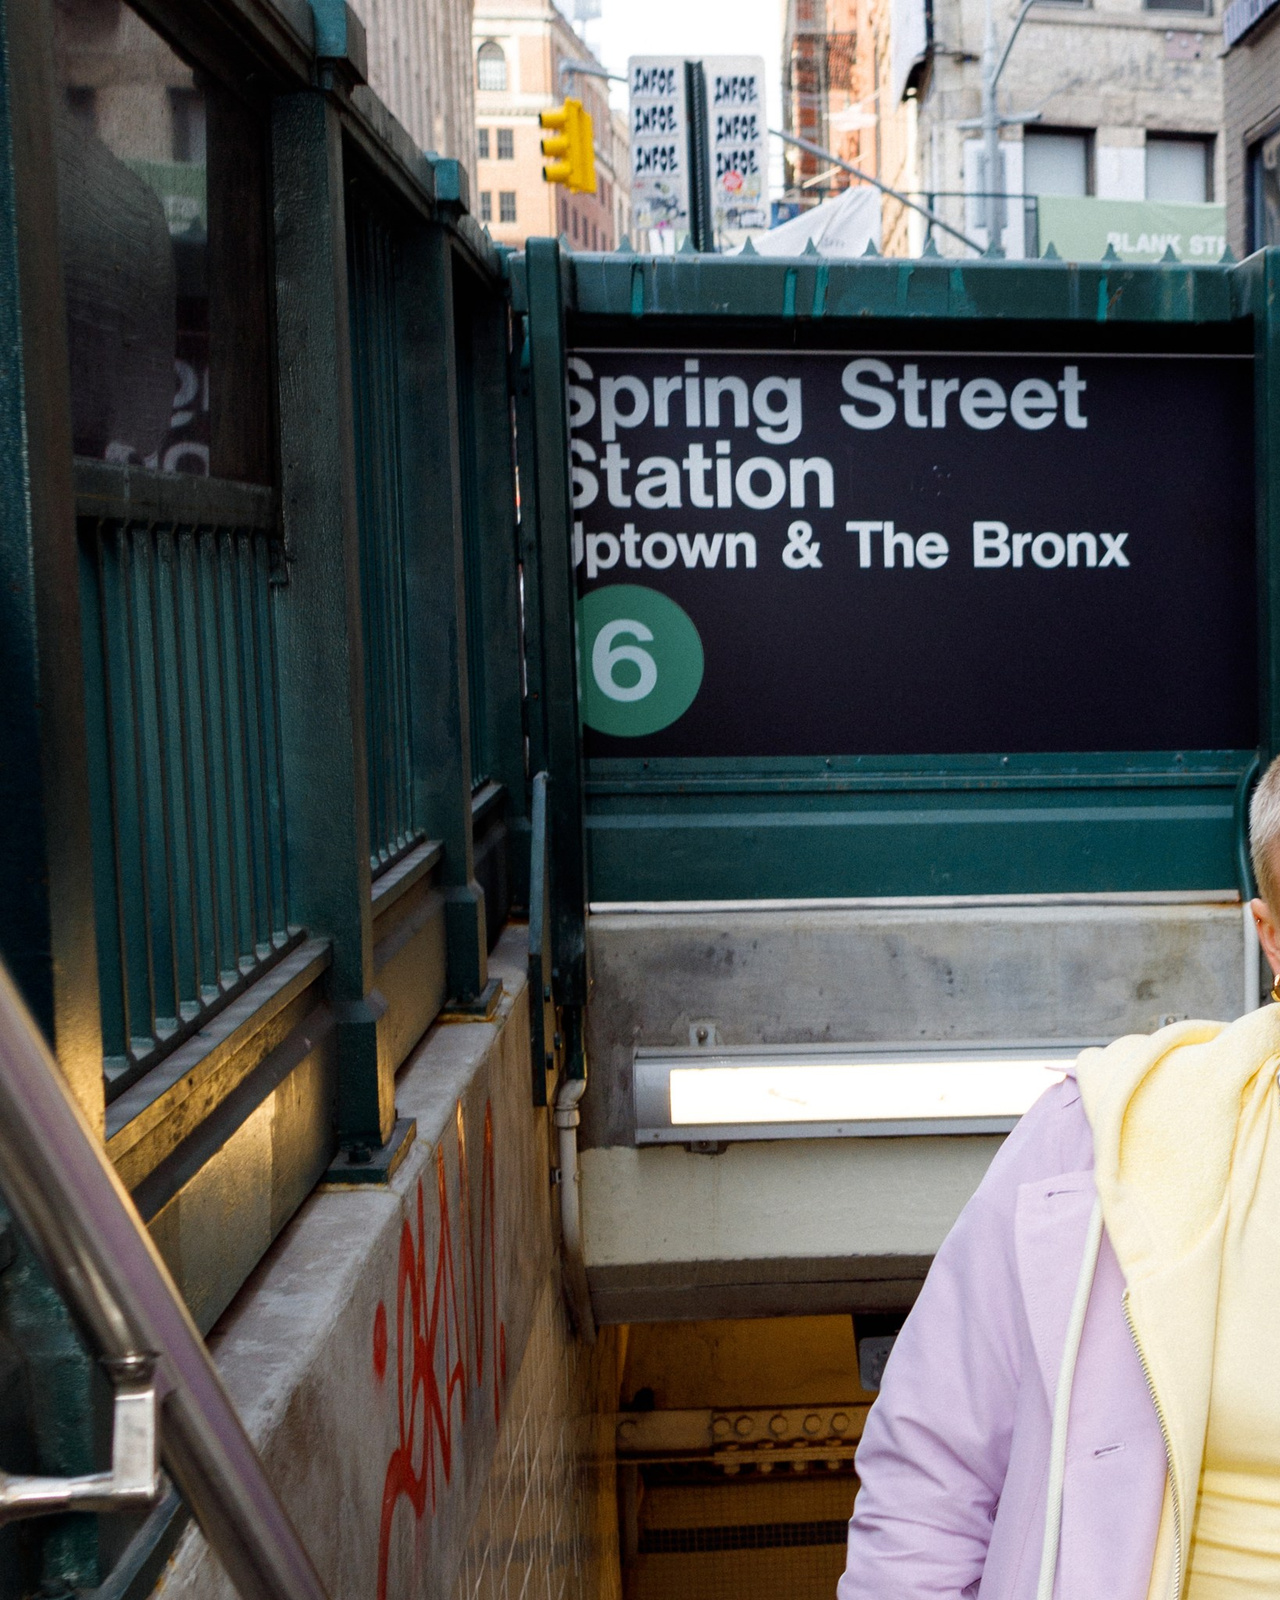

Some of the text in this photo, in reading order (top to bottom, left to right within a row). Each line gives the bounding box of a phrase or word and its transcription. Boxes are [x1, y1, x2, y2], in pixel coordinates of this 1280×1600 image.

[840, 358, 1088, 430] Street
[782, 520, 823, 568] &
[846, 521, 949, 568] The
[973, 521, 1130, 568] Bronx
[592, 619, 658, 703] 6
